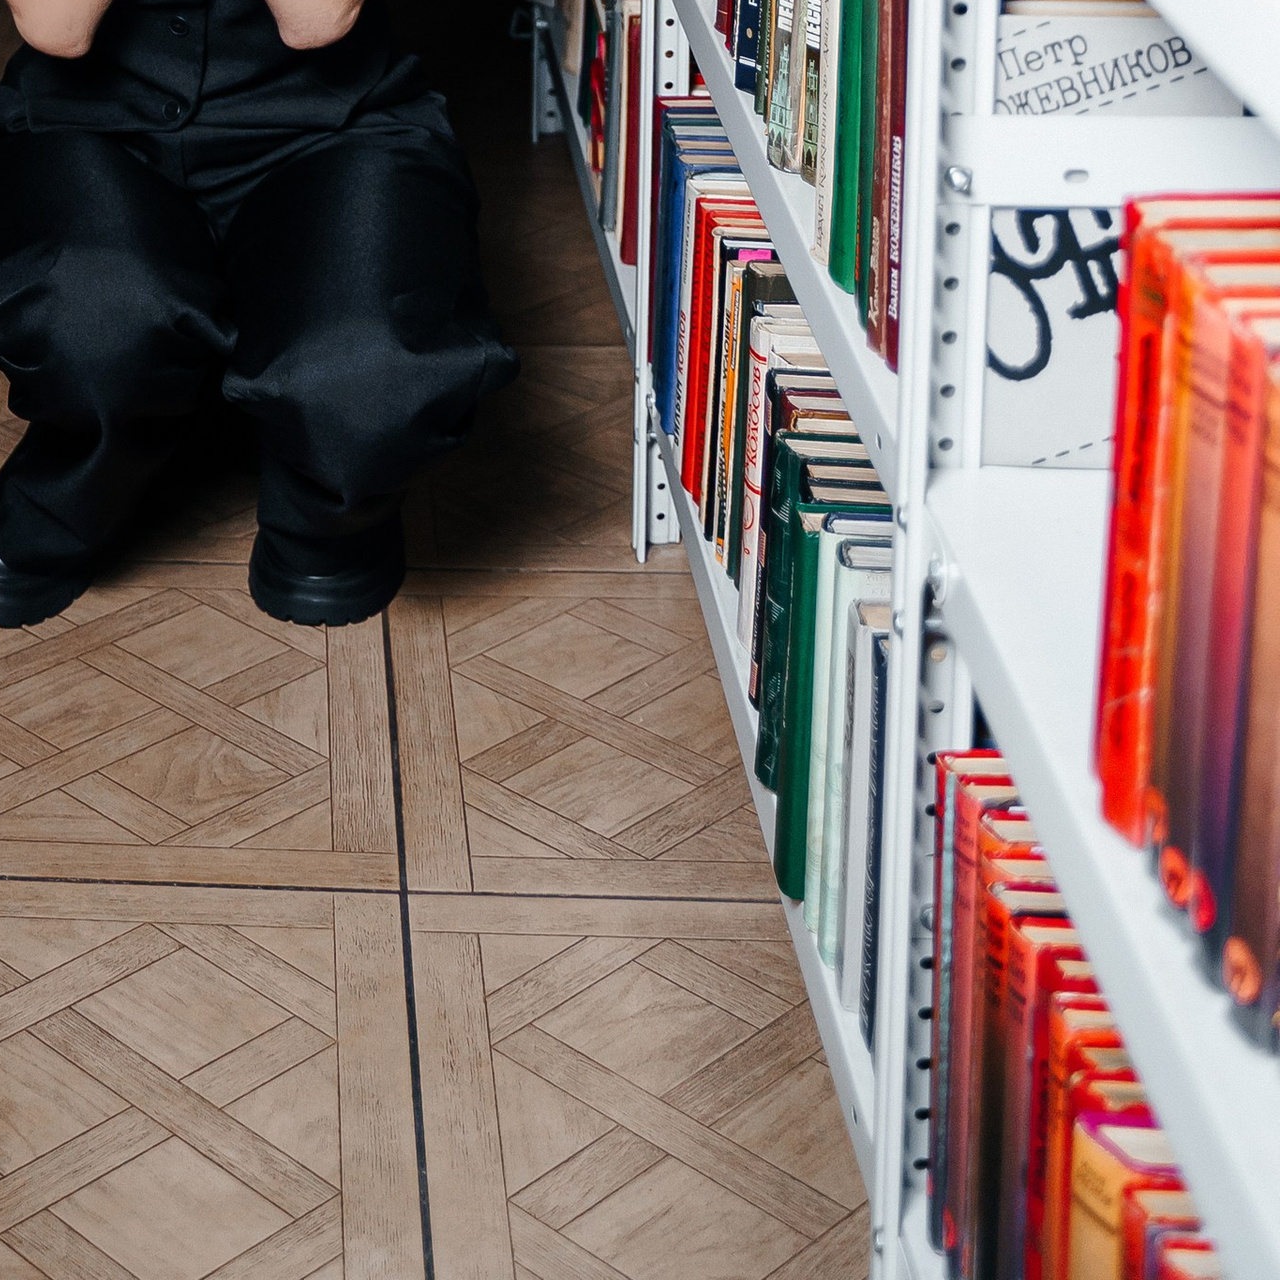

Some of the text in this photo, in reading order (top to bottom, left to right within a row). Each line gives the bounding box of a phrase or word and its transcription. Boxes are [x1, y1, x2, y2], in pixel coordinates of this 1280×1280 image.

[998, 34, 1089, 81] Петр
[886, 134, 904, 320] Вадим КОЖЕВНИКОВ
[677, 310, 687, 376] КОЗЛОВ
[747, 365, 762, 468] КОЛОСОВ
